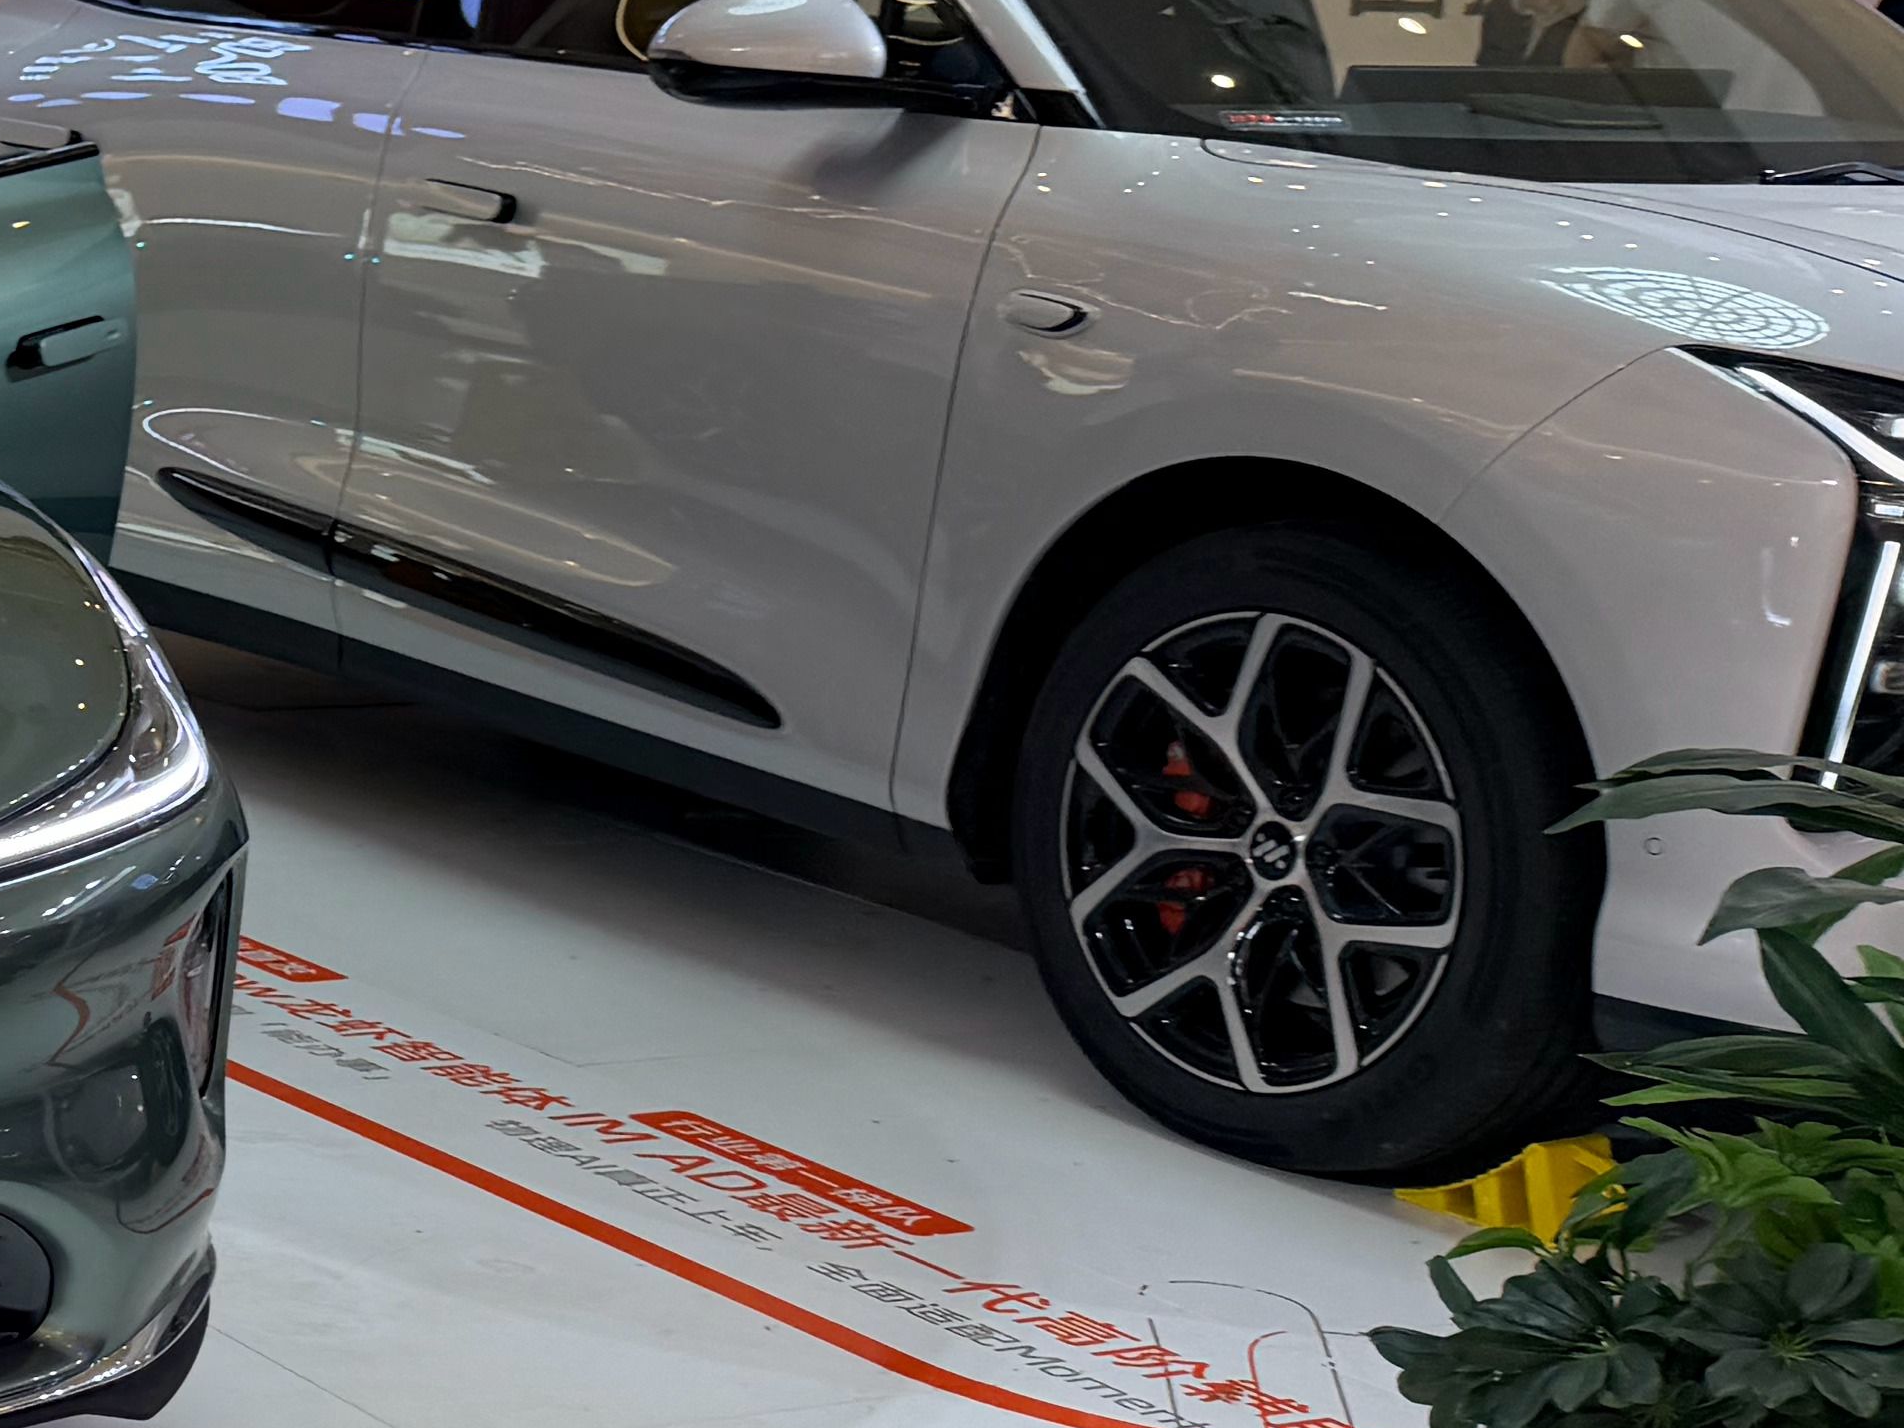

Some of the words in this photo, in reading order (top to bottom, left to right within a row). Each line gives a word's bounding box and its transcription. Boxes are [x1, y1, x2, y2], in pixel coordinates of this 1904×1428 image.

[659, 1117, 937, 1229] 行业第一梯队
